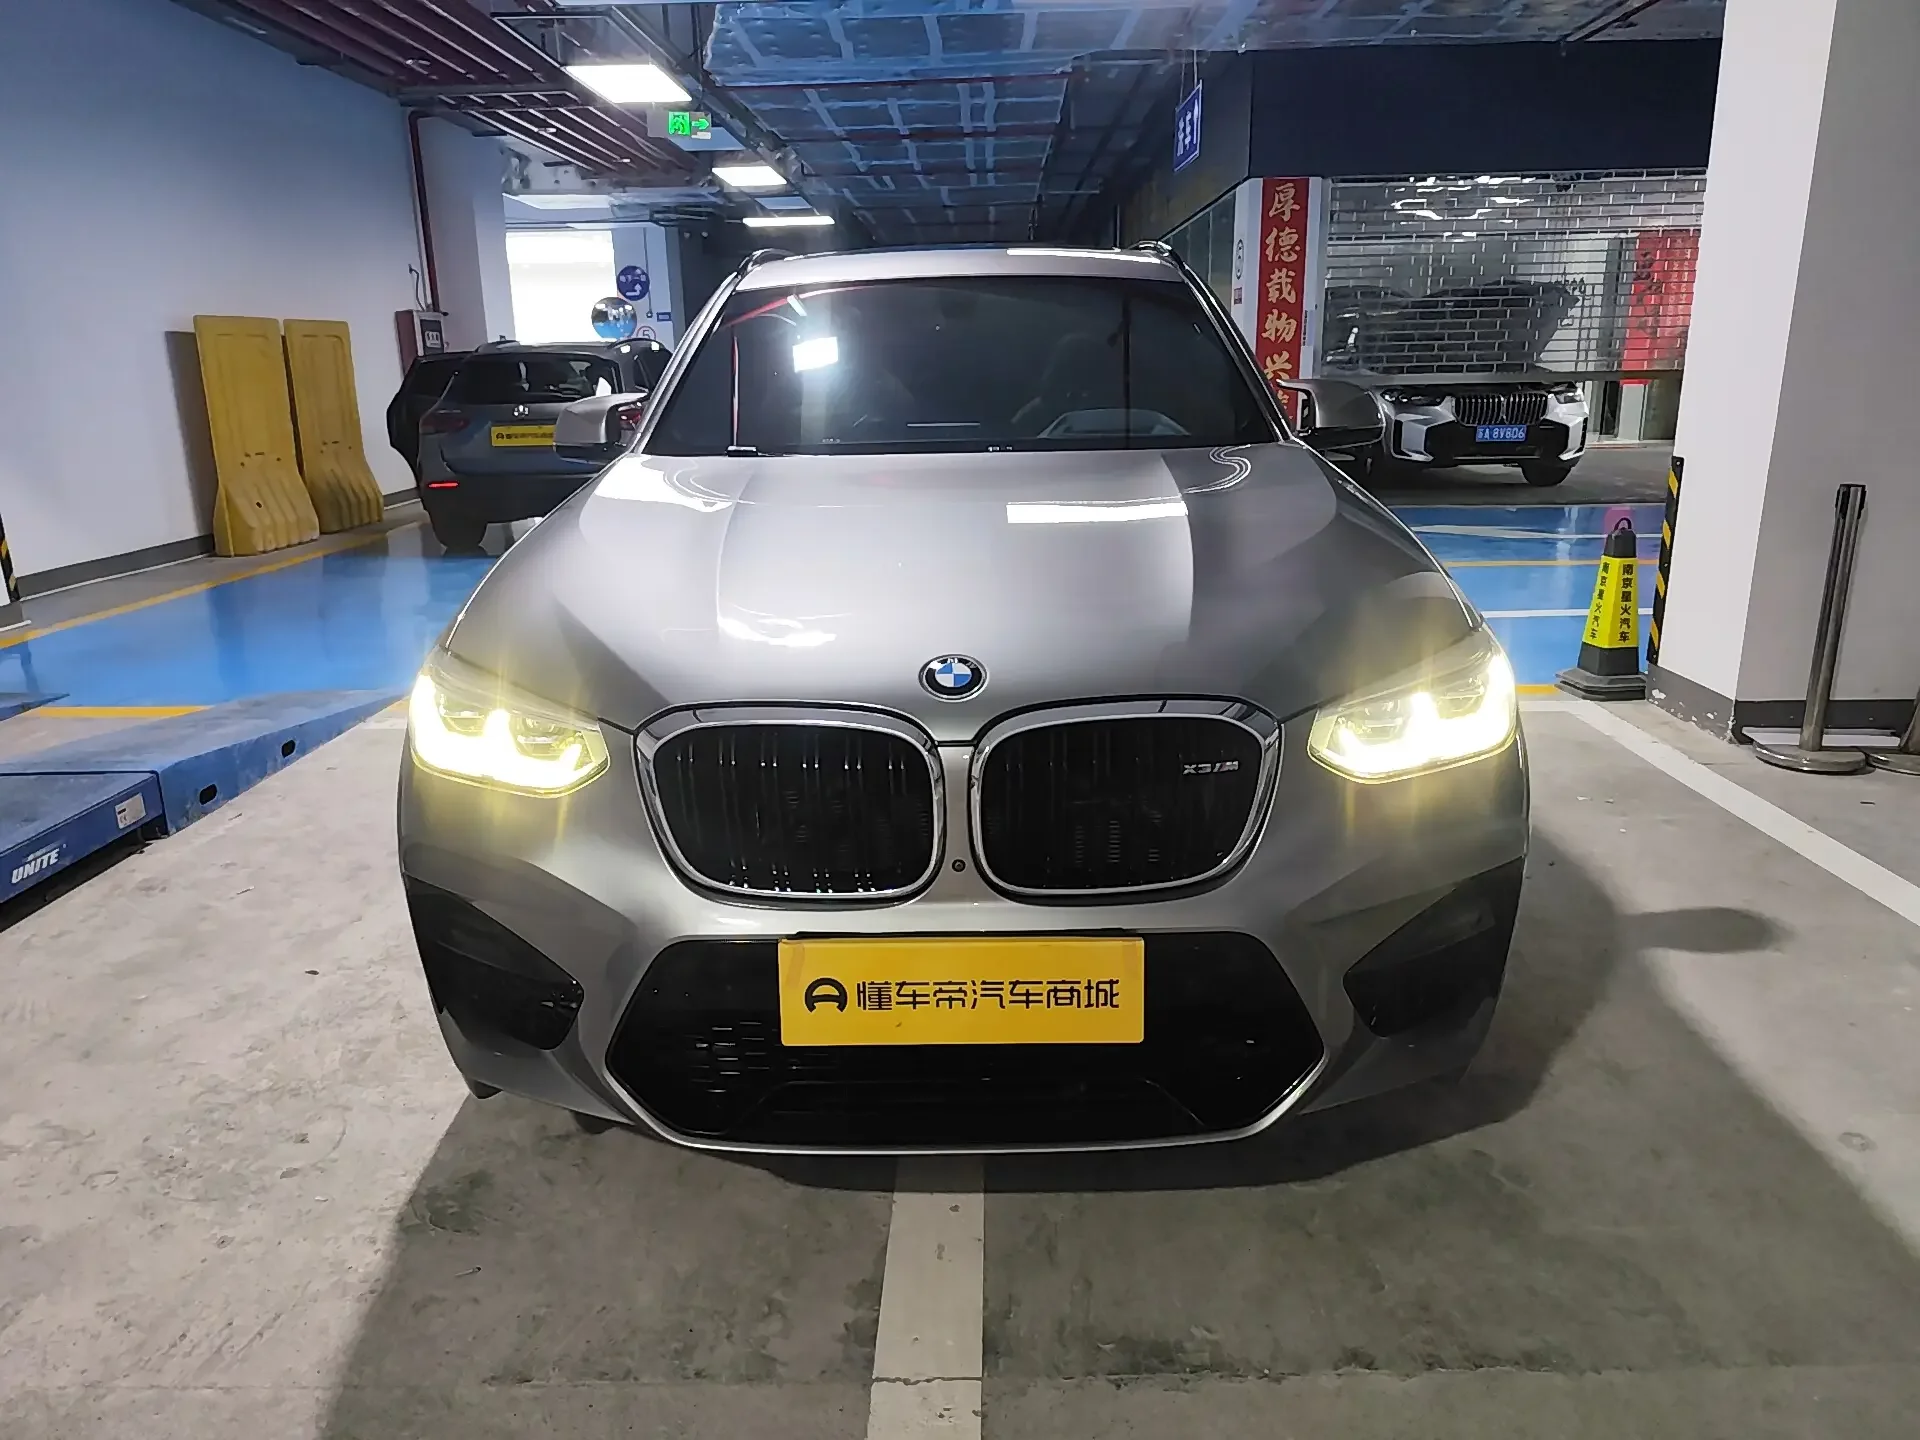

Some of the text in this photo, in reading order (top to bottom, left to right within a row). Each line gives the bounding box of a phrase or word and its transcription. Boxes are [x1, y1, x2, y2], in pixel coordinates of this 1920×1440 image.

[1590, 561, 1611, 639] 南京星火汽车
[1618, 563, 1634, 643] 南京星火汽车
[11, 847, 60, 884] UNITE
[856, 978, 1120, 1011] 懂车帝汽车商城
